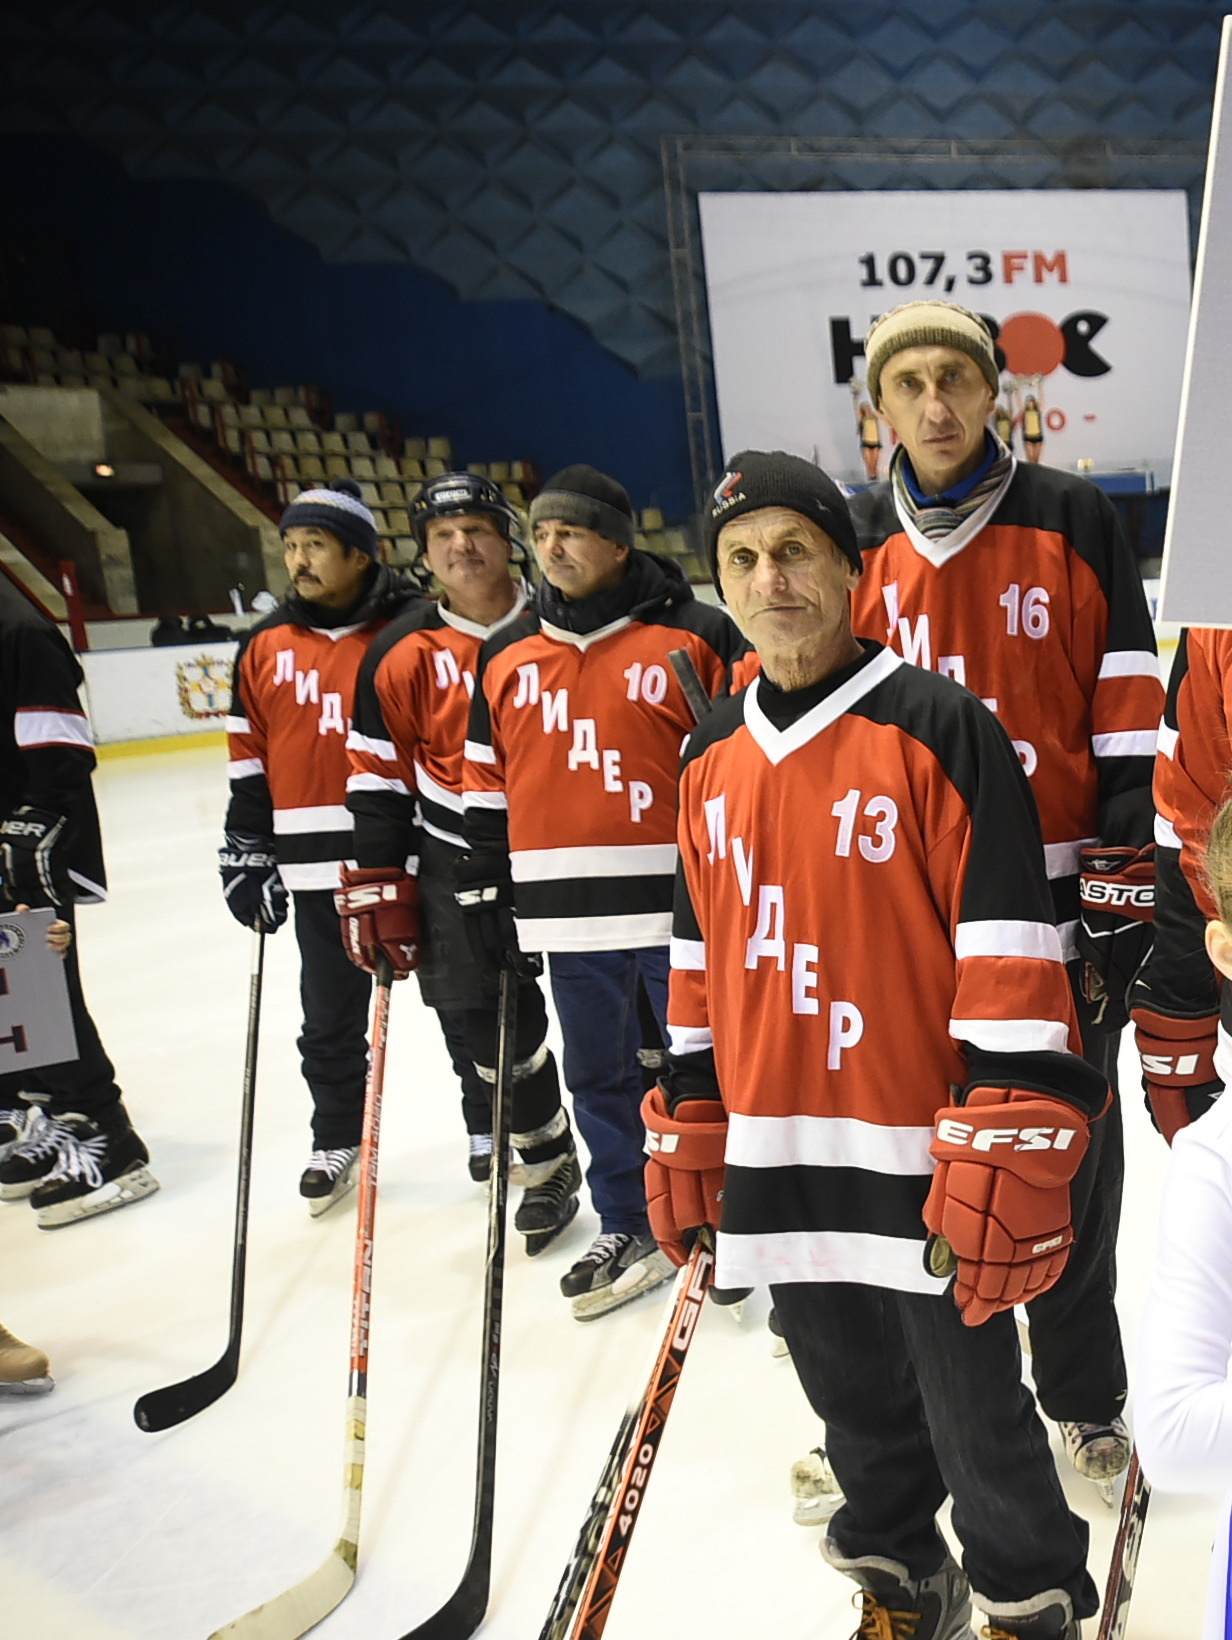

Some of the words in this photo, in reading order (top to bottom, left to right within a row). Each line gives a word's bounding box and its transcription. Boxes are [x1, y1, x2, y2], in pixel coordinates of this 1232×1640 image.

[858, 250, 994, 292] 107,3
[1002, 250, 1069, 284] FM
[711, 491, 747, 519] RUSSIA
[1000, 583, 1049, 639] 16
[623, 662, 668, 705] 10
[513, 662, 654, 823] ЛИДЕР
[831, 789, 898, 863] 13
[703, 792, 864, 1070] ЛИДЕР
[937, 1119, 1077, 1152] EFSI
[618, 1443, 654, 1537] 4020
